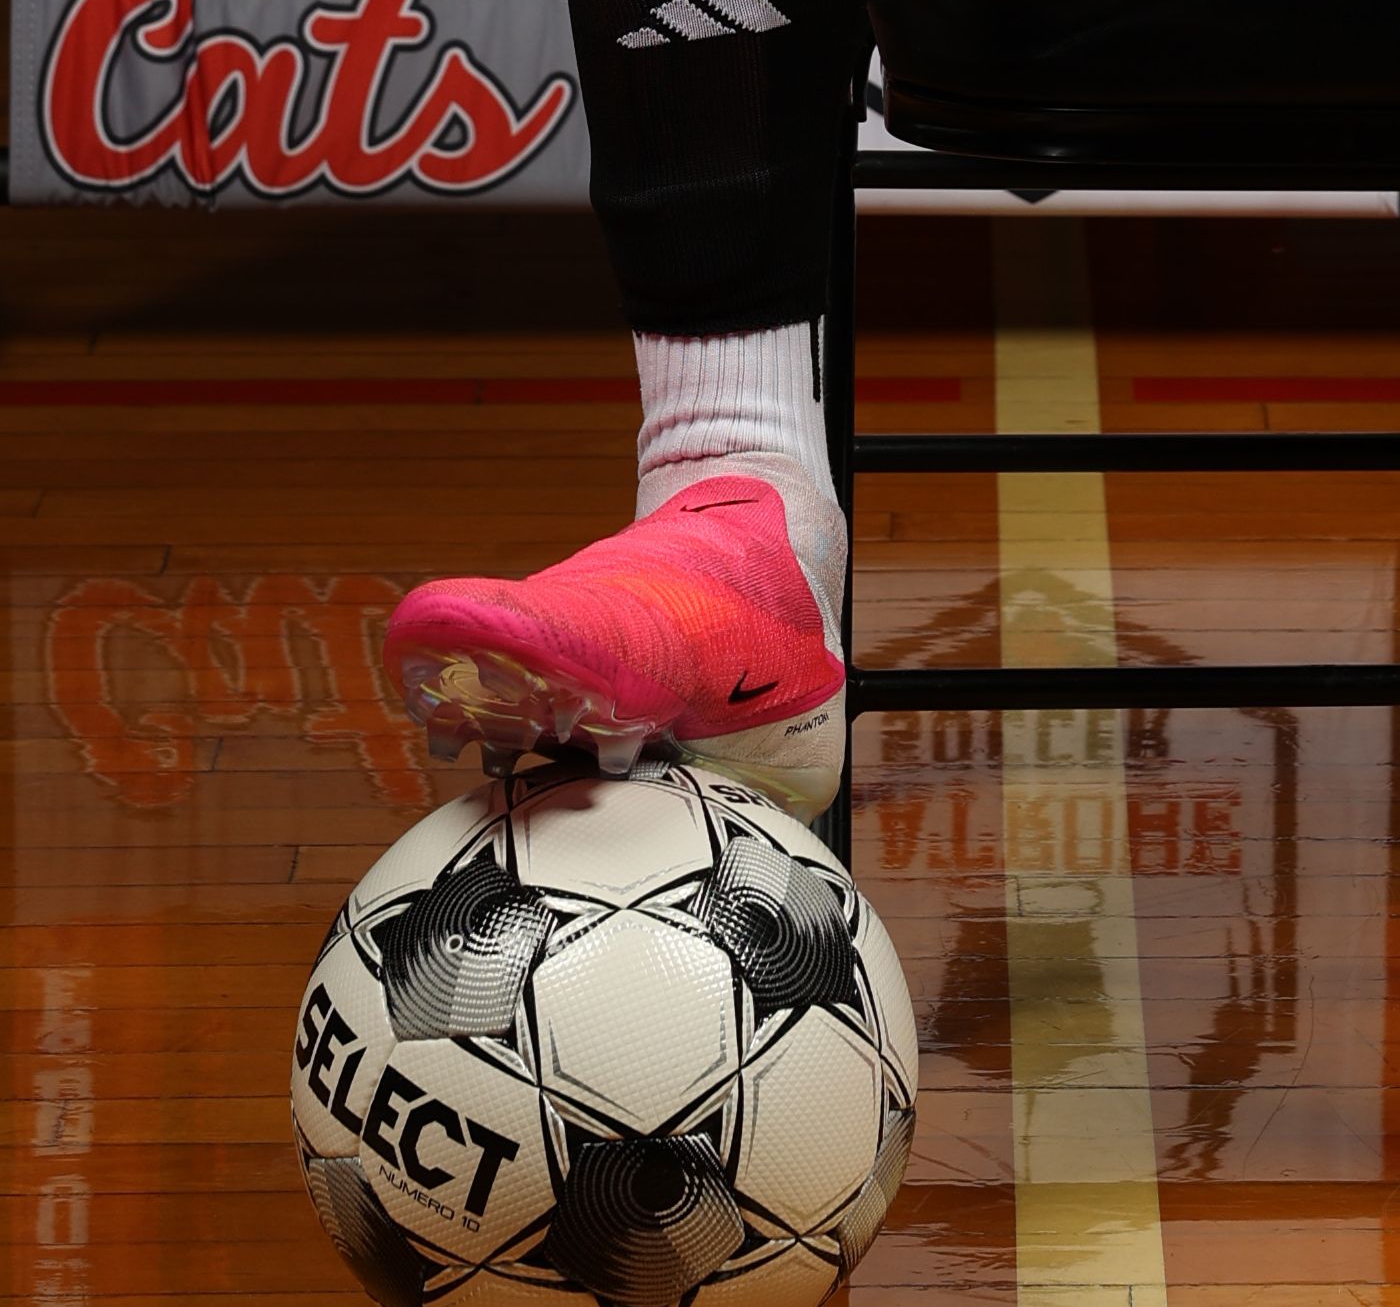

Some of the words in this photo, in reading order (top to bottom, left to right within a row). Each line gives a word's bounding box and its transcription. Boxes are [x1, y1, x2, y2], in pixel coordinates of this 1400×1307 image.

[295, 982, 521, 1218] SELECT
[376, 1163, 456, 1222] NUMERO
[460, 1213, 481, 1233] 10
